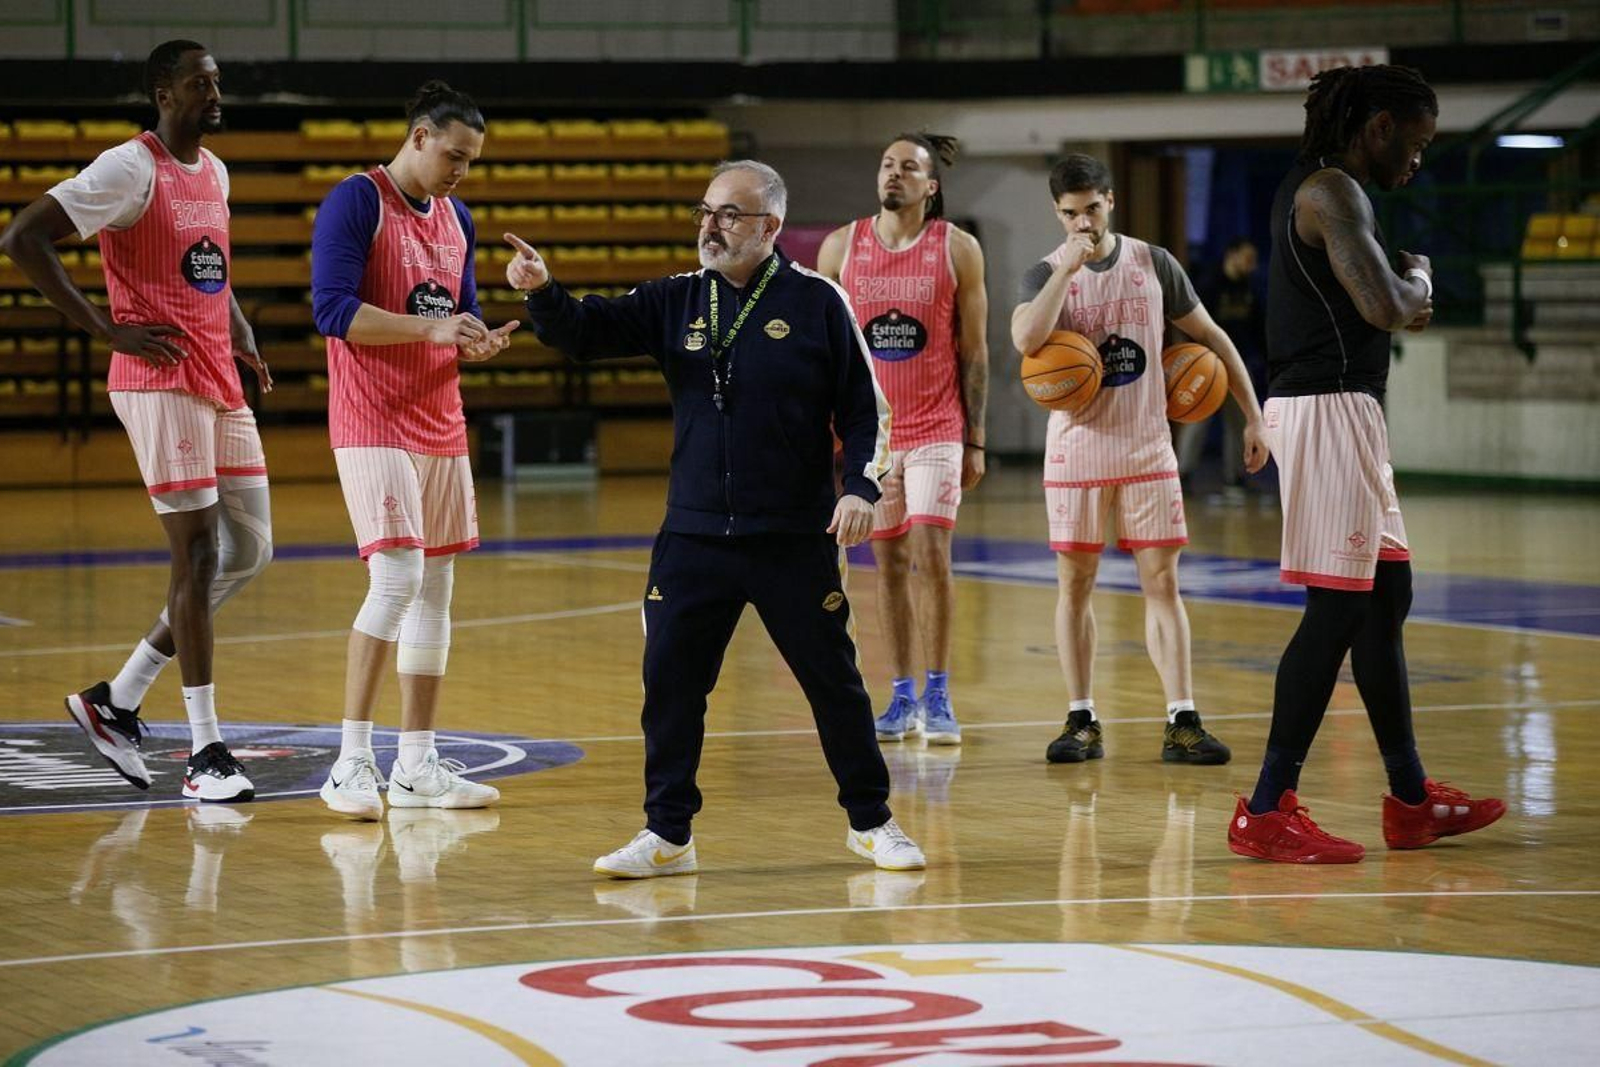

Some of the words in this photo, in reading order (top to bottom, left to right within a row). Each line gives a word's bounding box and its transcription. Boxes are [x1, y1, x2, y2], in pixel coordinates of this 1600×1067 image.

[191, 251, 222, 266] Estrella
[193, 265, 223, 280] Galicia
[854, 275, 936, 305] 32005
[415, 291, 454, 309] Estrella
[722, 328, 737, 347] CLUB
[733, 298, 756, 329] OURENSE
[871, 323, 917, 336] Estrella
[873, 335, 915, 349] Galicia
